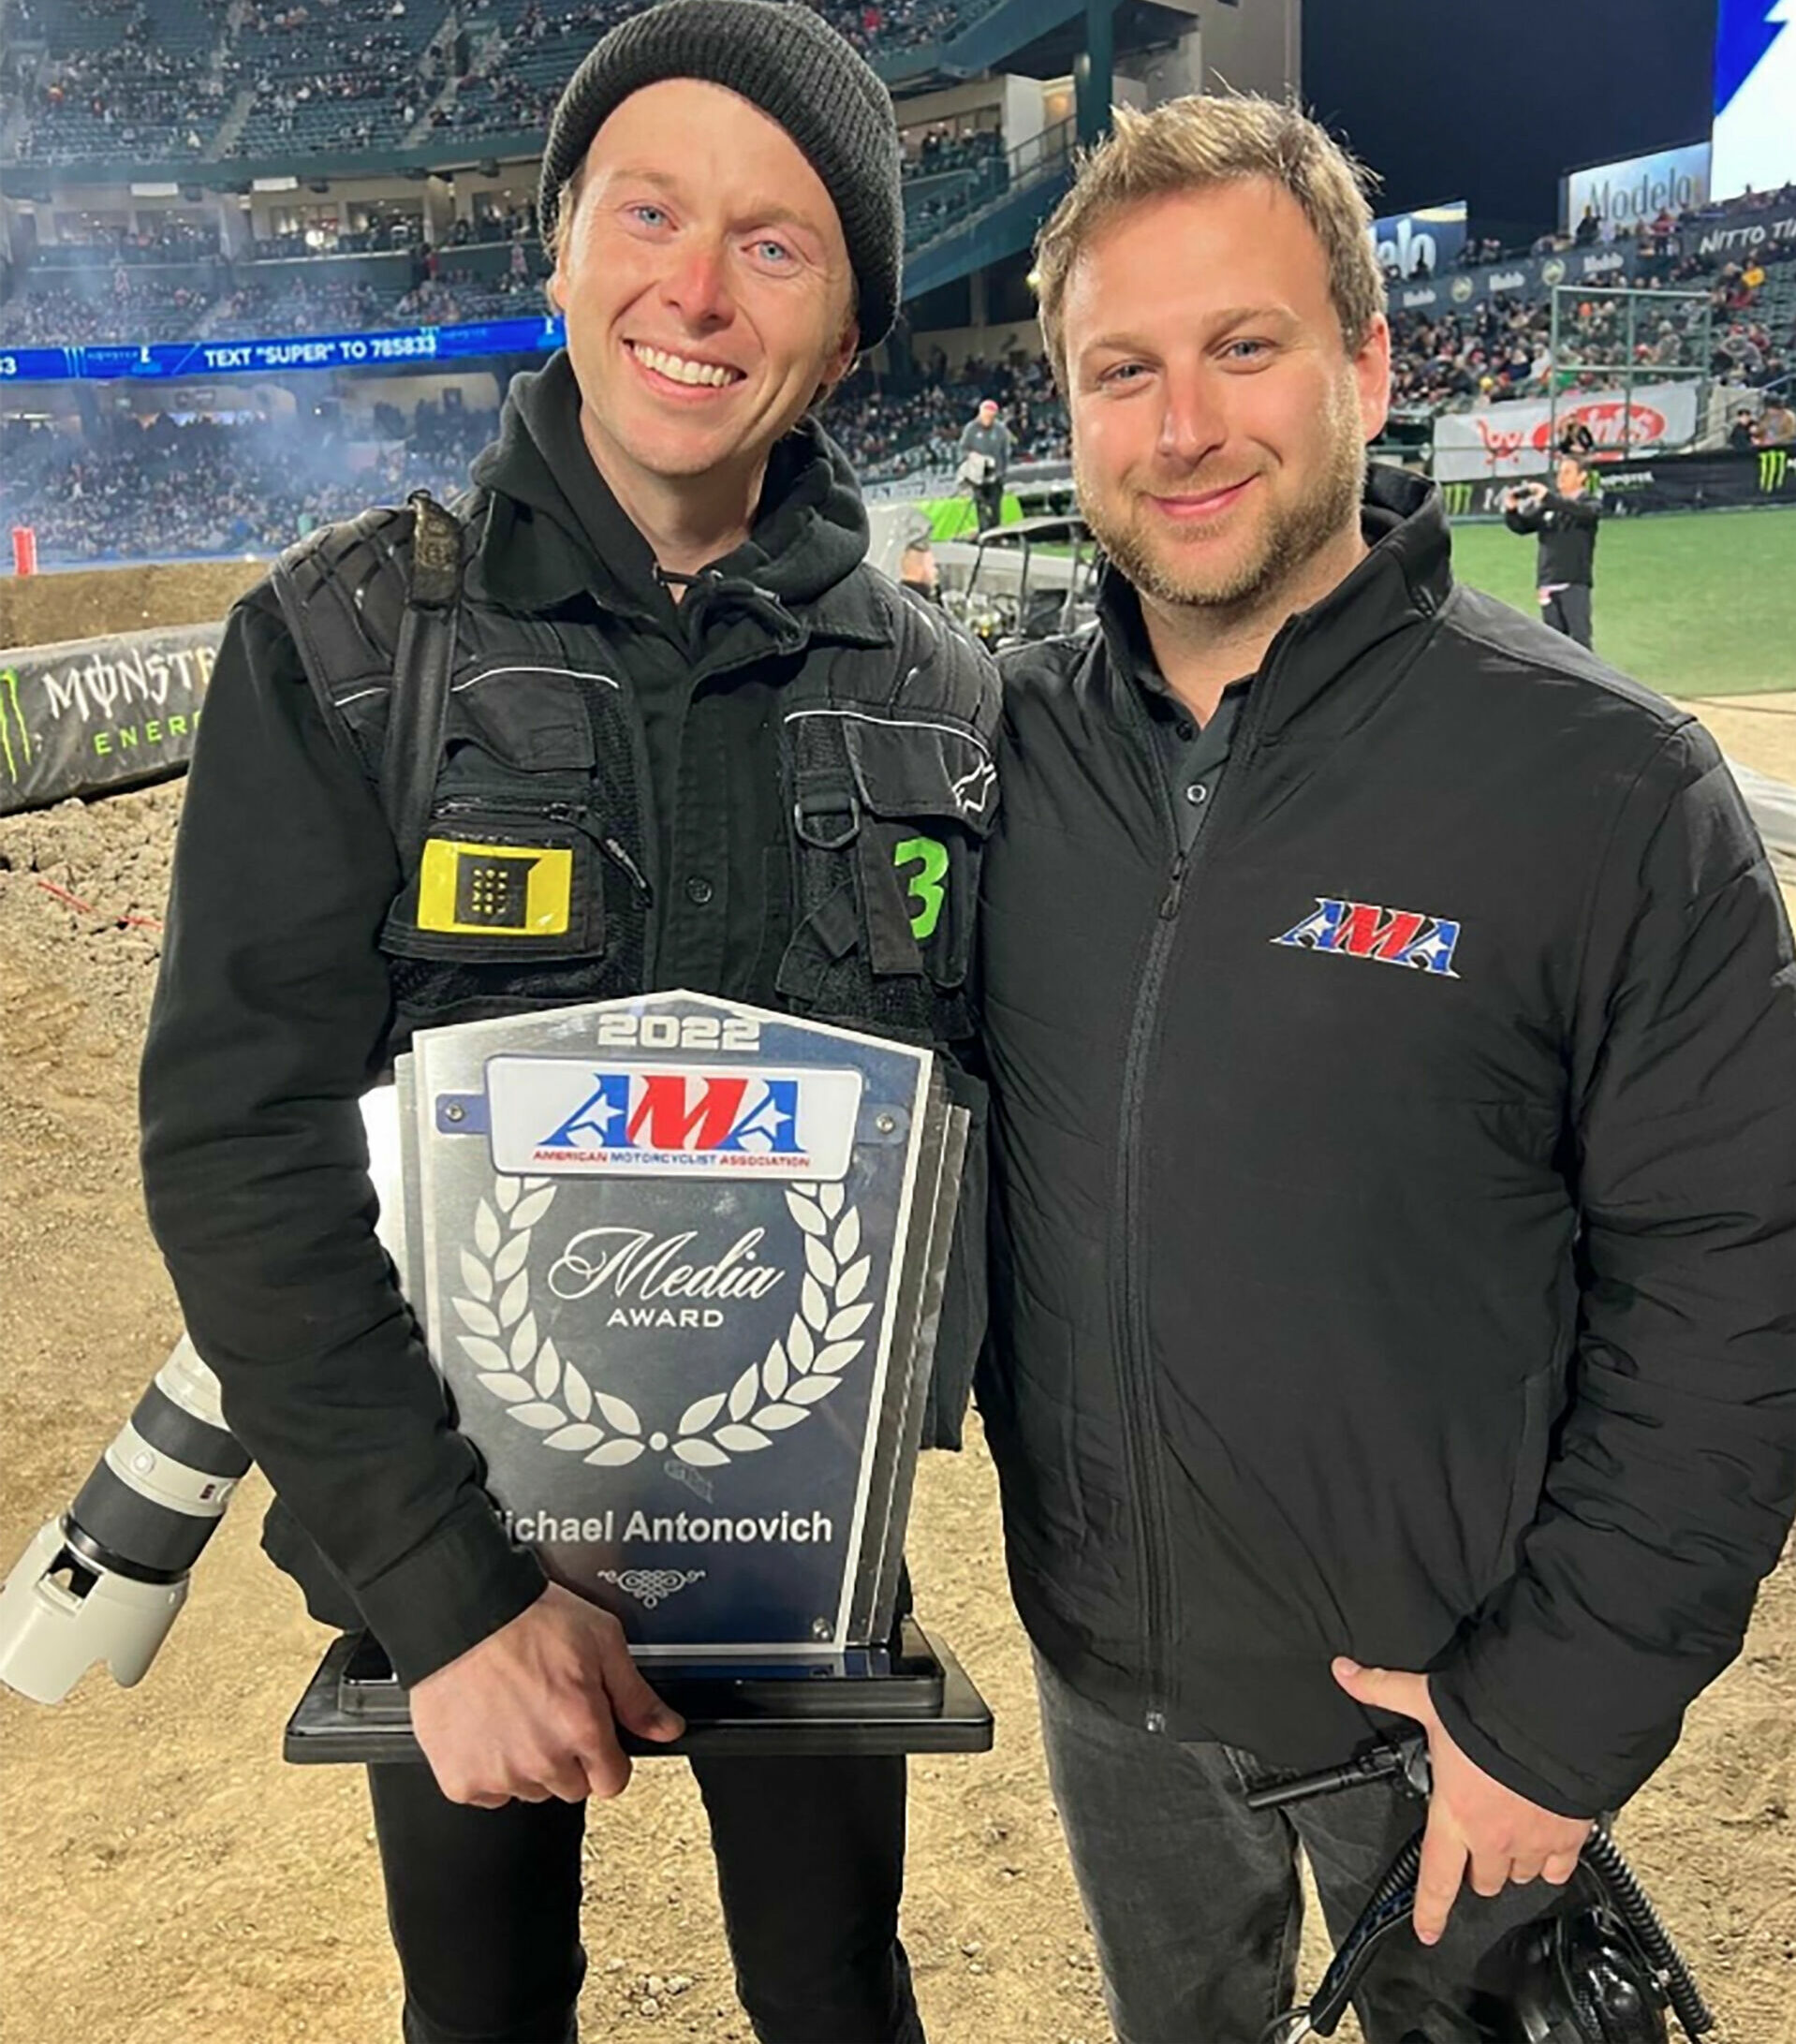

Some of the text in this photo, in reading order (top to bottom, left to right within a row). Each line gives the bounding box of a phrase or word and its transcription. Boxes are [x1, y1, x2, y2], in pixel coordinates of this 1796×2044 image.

[1589, 167, 1691, 220] Modelo
[1699, 226, 1766, 255] NITTO
[204, 334, 436, 368] TEXT "SUPER" TO 785833
[95, 711, 200, 756] ENER
[894, 836, 950, 939] 3
[1269, 897, 1461, 978] AMA
[597, 1013, 760, 1051] 2022
[537, 1072, 807, 1154] AMA
[532, 1150, 810, 1168] AMERICAN MOTORCYCLIST ASSOCIATION
[548, 1227, 786, 1301] Media
[607, 1308, 724, 1328] AWARD
[494, 1509, 832, 1543] ichael Antonovich
